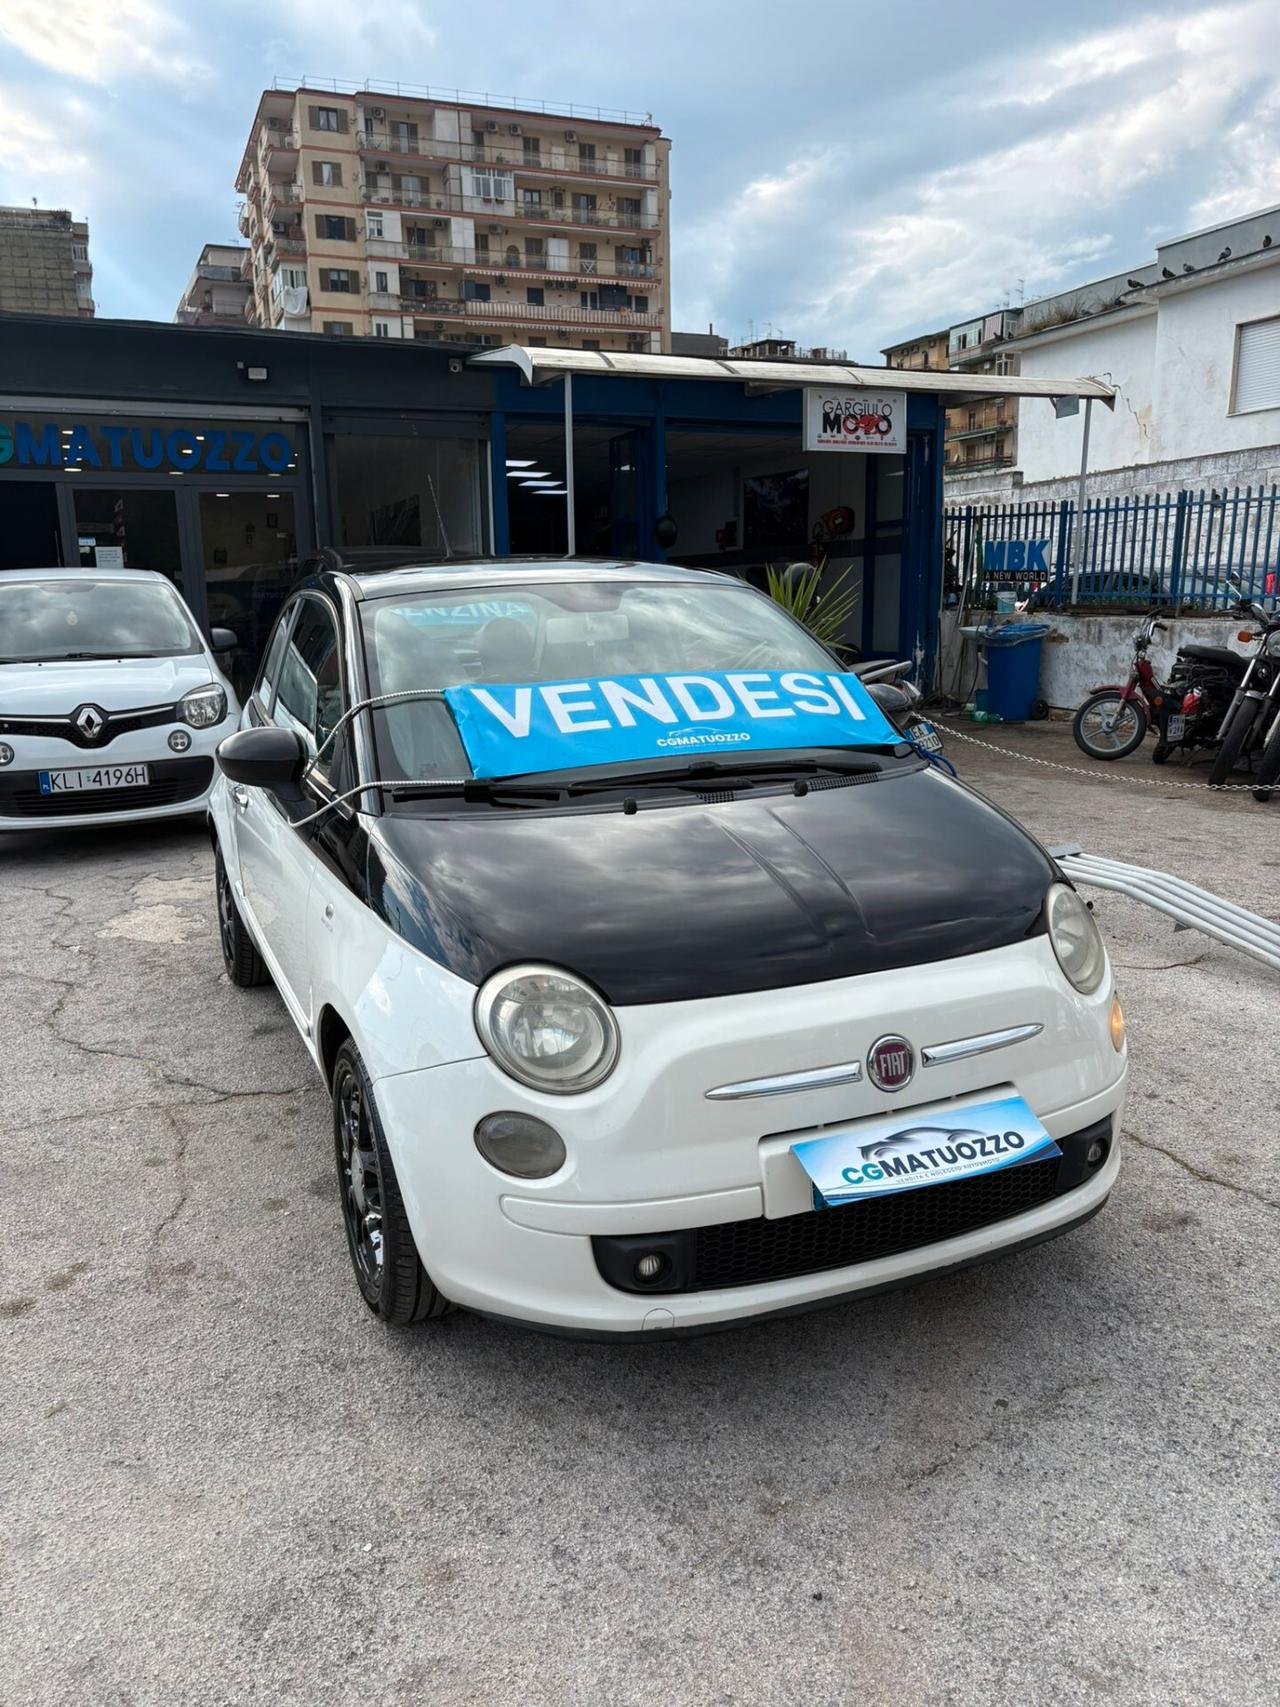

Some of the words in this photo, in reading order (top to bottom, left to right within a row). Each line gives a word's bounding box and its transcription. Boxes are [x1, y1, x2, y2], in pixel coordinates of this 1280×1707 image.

[822, 400, 893, 416] GARGIULO
[984, 540, 1050, 570] MBK
[985, 572, 991, 580] A
[993, 571, 1012, 581] NEW
[1015, 571, 1047, 581] WORLD
[471, 672, 866, 739] VENDESI
[656, 732, 751, 747] CGMATUOZZO
[51, 771, 82, 790] KLI
[92, 767, 145, 786] 4196H
[880, 1050, 906, 1077] FIAT
[841, 1130, 1025, 1185] CGMATUOZZO
